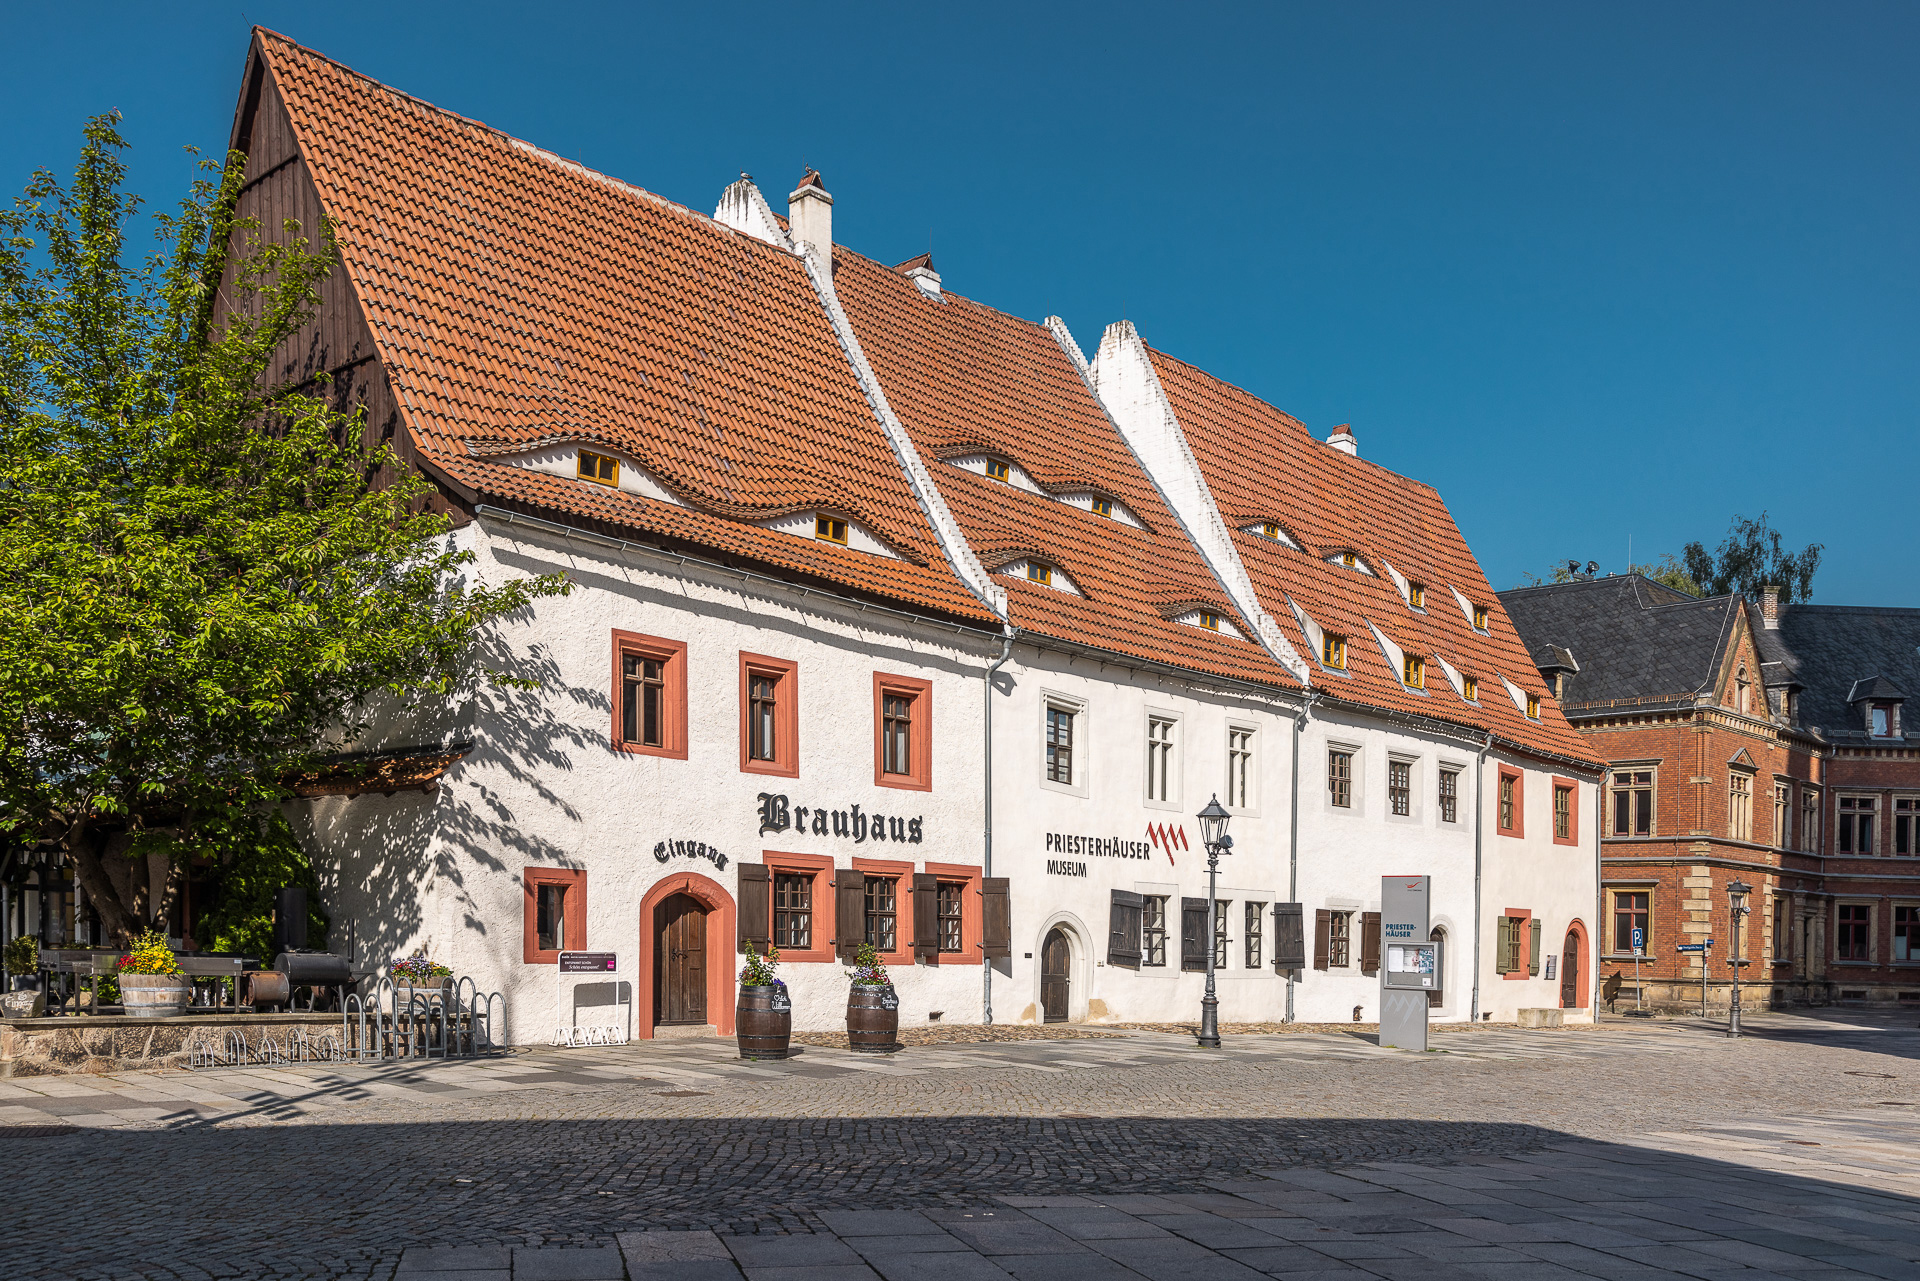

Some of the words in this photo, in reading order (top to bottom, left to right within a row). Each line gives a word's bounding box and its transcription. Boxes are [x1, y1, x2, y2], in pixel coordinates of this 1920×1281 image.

[757, 792, 923, 844] Brauhaus
[653, 838, 730, 871] Eingang
[1046, 832, 1150, 860] PRIESTERHÄUSER
[1046, 859, 1087, 878] MUSEUM
[1385, 929, 1411, 937] HÄUSER
[1634, 931, 1640, 945] P
